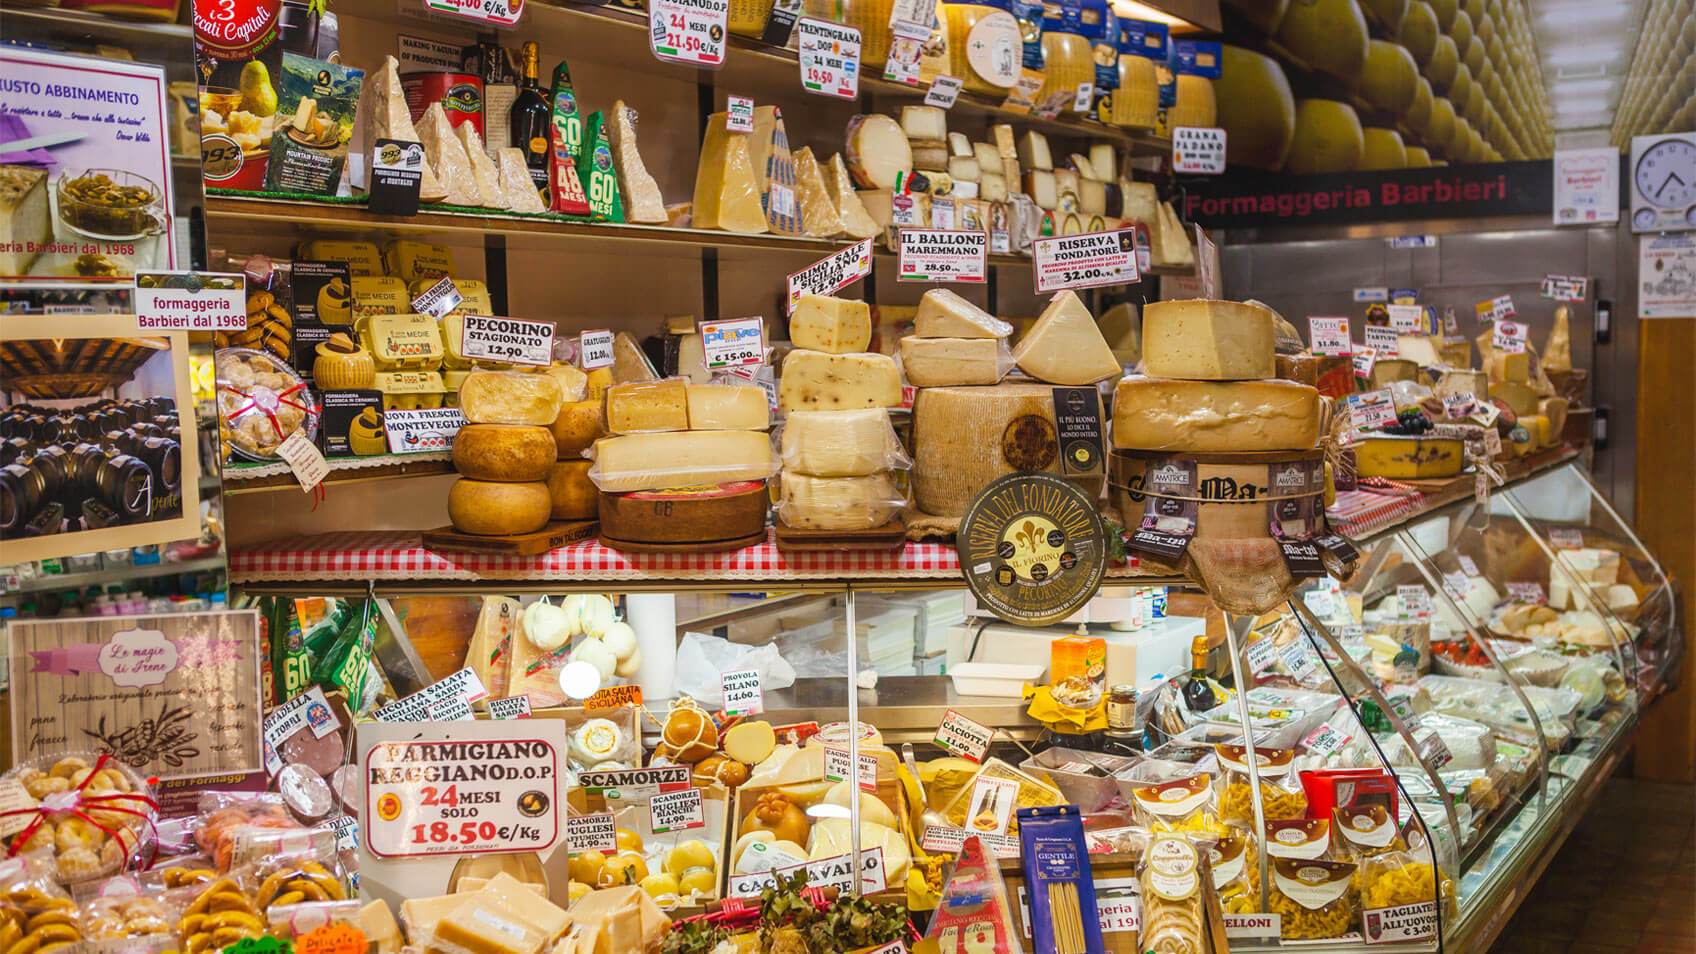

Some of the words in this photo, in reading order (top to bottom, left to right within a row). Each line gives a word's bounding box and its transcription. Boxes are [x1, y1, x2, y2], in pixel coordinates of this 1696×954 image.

[217, 0, 235, 20] 3
[224, 6, 271, 42] Capitali
[670, 14, 685, 31] 24
[689, 22, 707, 32] MESI
[800, 22, 861, 45] TRENTINGRANA
[667, 33, 700, 51] 21.50
[817, 40, 832, 51] DOP
[807, 68, 833, 84] 19.50
[45, 84, 139, 106] ABBINAMENTO
[286, 150, 311, 161] MOUNTAIN
[312, 153, 334, 165] PRODUCT
[557, 165, 582, 193] 48
[591, 172, 615, 201] 60
[560, 190, 585, 203] MESI
[1186, 189, 1370, 217] Formaggeria
[1382, 175, 1506, 207] Barbieri
[590, 201, 613, 216] MESI
[902, 234, 915, 243] IL
[919, 234, 986, 245] BALLONE
[1059, 236, 1115, 251] RISERVA
[26, 242, 78, 254] Barbieri
[82, 243, 100, 254] dal
[105, 244, 135, 255] 1968
[906, 246, 979, 255] MAREMMANO
[1055, 246, 1119, 261] FONDATORE
[793, 261, 829, 285] PRIMO
[835, 243, 865, 264] SALE
[801, 254, 859, 289] SICILIANO
[925, 264, 951, 272] 28.50
[1063, 269, 1100, 282] 32.00
[153, 297, 230, 312] formaggeria
[139, 315, 189, 327] Barbieri
[193, 315, 212, 327] dal
[216, 316, 246, 327] 1968
[466, 317, 551, 337] PECORINO
[469, 332, 542, 346] STAGIONATO
[488, 345, 522, 357] 12.90
[725, 351, 753, 360] 15.00
[385, 412, 414, 421] UOVA
[419, 410, 461, 419] FRESCHI
[387, 420, 467, 431] MONTEVEGLIO
[1154, 474, 1188, 483] AMATRICE
[1278, 476, 1305, 486] AMATRICE
[969, 507, 1007, 559] RISERVA
[992, 487, 1023, 519] DEL
[1022, 483, 1095, 540] FONDATORE
[549, 536, 563, 547] BON
[565, 529, 594, 544] TALEGGIO
[1022, 552, 1059, 565] FIORINO
[1018, 577, 1068, 601] PECORINO
[111, 645, 129, 658] Le
[133, 647, 165, 661] magie
[114, 663, 127, 673] di
[132, 661, 167, 673] Irene
[284, 653, 311, 686] 60
[723, 671, 758, 682] PROVOLA
[723, 680, 759, 691] SILANO
[374, 693, 425, 718] RICOTTA
[427, 669, 472, 695] SALATA
[727, 691, 753, 702] 14.60
[383, 701, 432, 722] SICILIANA
[435, 681, 467, 699] SARDA
[433, 699, 458, 711] CACIO
[490, 696, 526, 707] RICOTTA
[493, 703, 525, 713] SALATA
[263, 693, 312, 731] ORTADELLA
[432, 703, 467, 720] RICOTTA
[495, 709, 523, 718] SARDA
[275, 714, 301, 738] TORRI
[943, 721, 987, 747] CACIOTTA
[946, 737, 970, 751] 11.00
[386, 742, 548, 763] PARMIGIANO
[187, 773, 247, 788] Formaggi
[371, 764, 505, 784] REGGIANO
[505, 767, 555, 780] D.O.P.
[580, 769, 687, 787] SCAMORZE
[420, 785, 458, 807] 24
[459, 792, 501, 804] MESI
[653, 791, 698, 804] SCAMORZE
[441, 807, 478, 818] SOLO
[652, 799, 701, 812] PUGLIESI
[657, 806, 695, 818] BIANCHE
[660, 816, 685, 825] 14.90
[412, 821, 496, 845] 18.50
[497, 824, 540, 841] €/Kg
[573, 840, 598, 848] 14.90
[1383, 904, 1433, 918] TAGLIATE
[1224, 919, 1272, 929] ELLONI
[1412, 925, 1431, 935] 3.00
